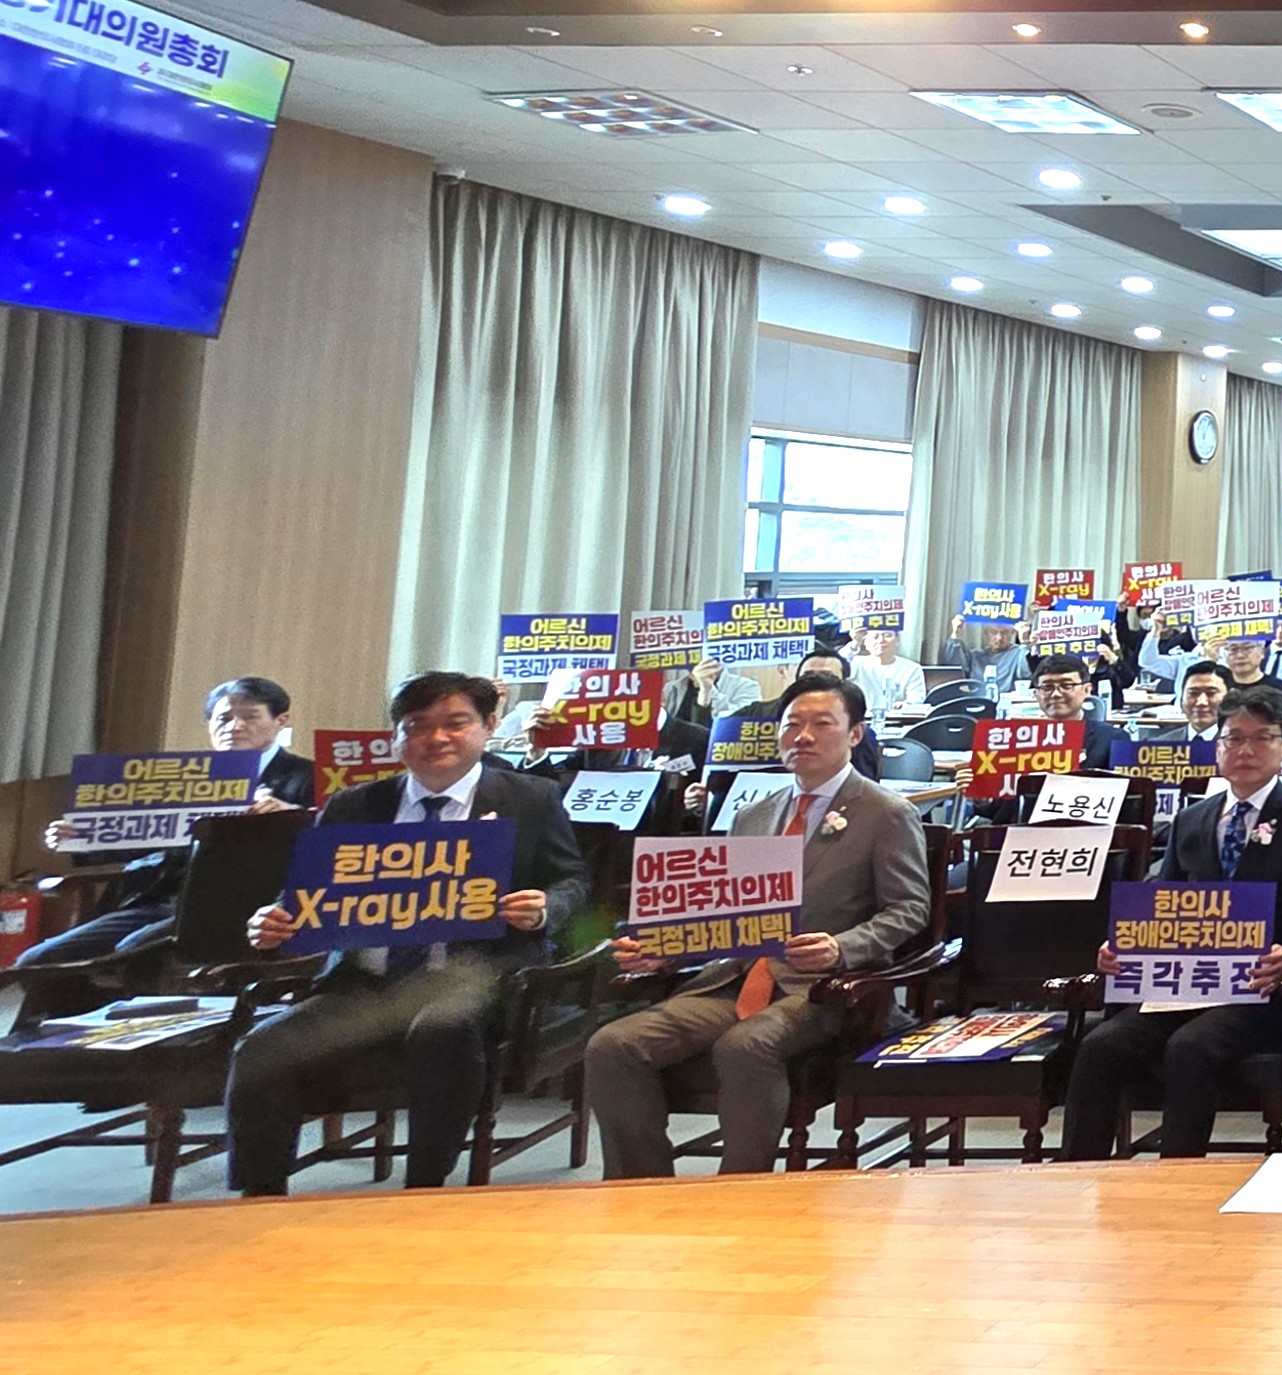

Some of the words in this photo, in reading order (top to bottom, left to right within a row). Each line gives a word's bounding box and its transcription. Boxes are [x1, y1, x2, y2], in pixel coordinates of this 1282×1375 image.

[1197, 587, 1240, 604] 어르신
[633, 615, 683, 633] 어르신
[731, 604, 784, 619] 어르신
[530, 618, 586, 635] 어르신
[707, 618, 810, 639] 한의주치의제
[503, 635, 613, 653] 한의주치의제
[573, 722, 626, 746] 사용
[988, 723, 1065, 750] 한의사
[976, 750, 1072, 775] X-ray
[1138, 746, 1191, 765] 어르신
[123, 757, 212, 780] 어르신
[74, 779, 250, 808] 한의주치의제
[571, 788, 643, 812] 홍순봉
[1042, 794, 1115, 819] 노용신
[71, 813, 178, 844] 국정과제
[333, 840, 470, 884] 한의사
[636, 845, 728, 884] 어르신
[1007, 847, 1099, 877] 전현희
[636, 871, 793, 917] 한의주치의제
[1155, 890, 1232, 918] 한의사
[637, 919, 731, 956] 국정과제
[737, 913, 792, 947] 채택!
[1116, 921, 1266, 949] 장애인주치의제
